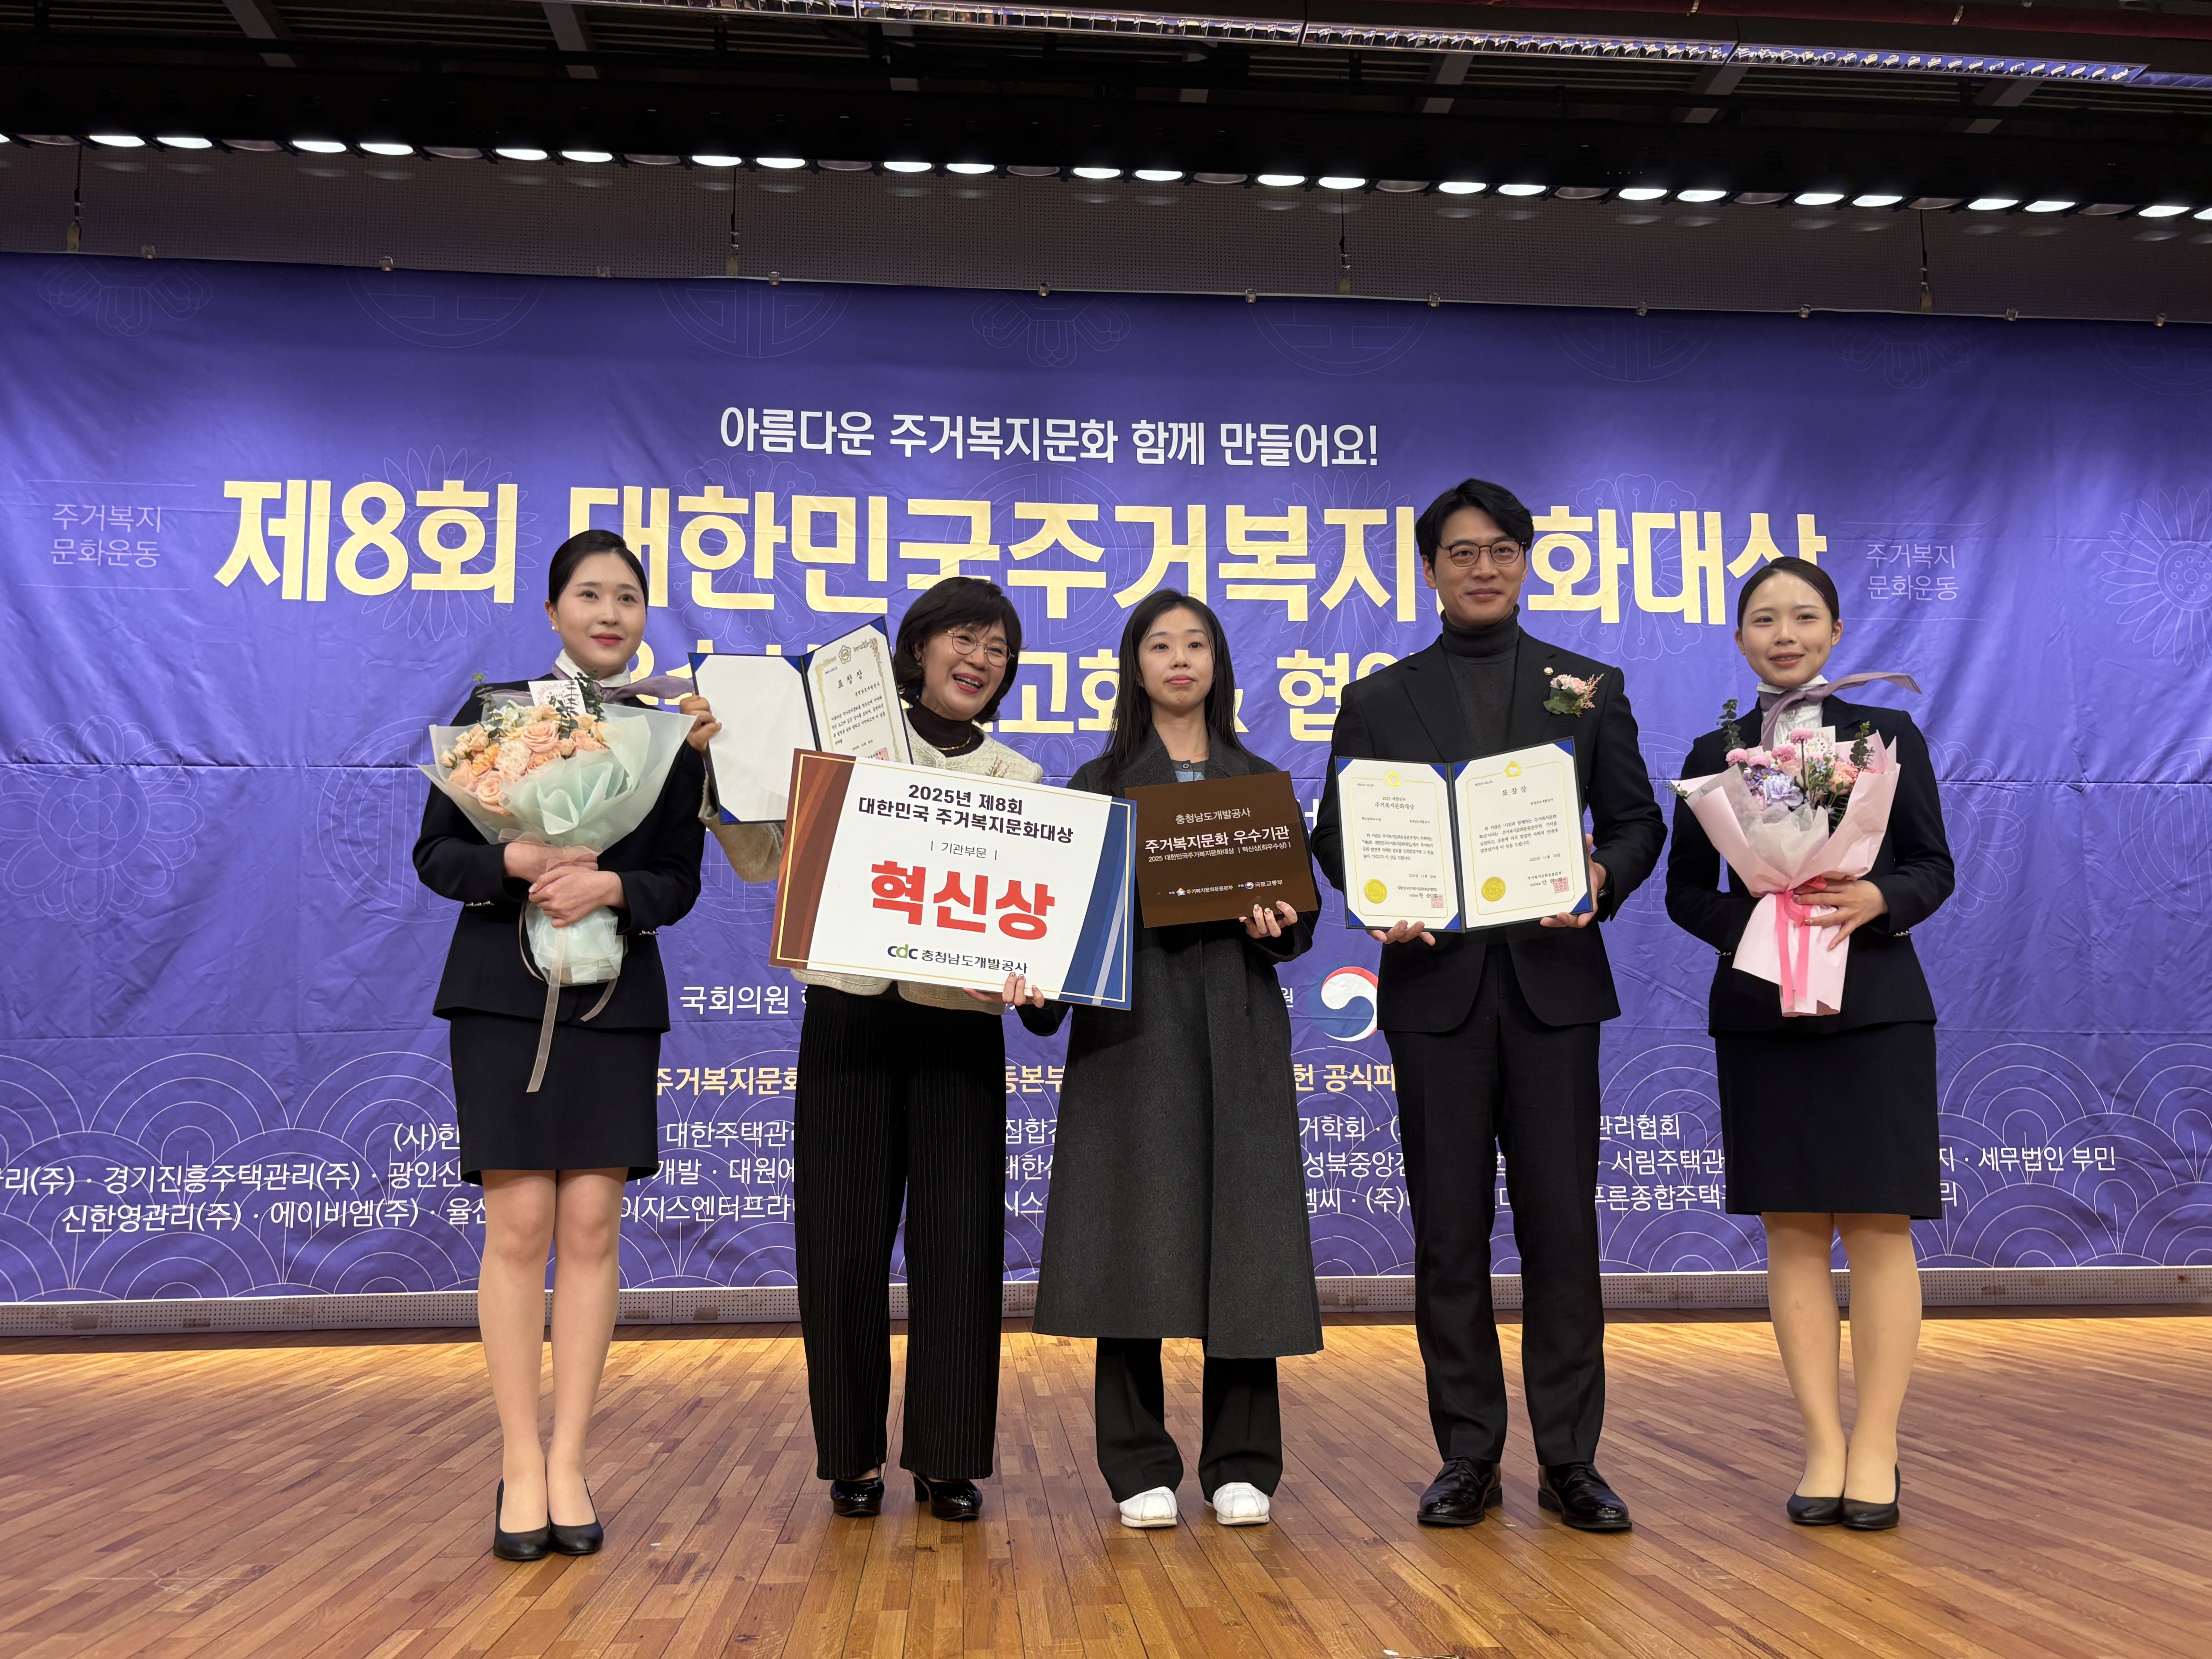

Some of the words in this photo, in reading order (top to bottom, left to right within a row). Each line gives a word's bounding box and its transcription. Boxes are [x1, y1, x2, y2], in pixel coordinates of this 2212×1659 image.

[720, 407, 875, 456] 아름다운
[890, 414, 1118, 464] 주거복지문화
[1131, 420, 1204, 465] 함께
[1220, 424, 1377, 467] 만들어요!
[52, 505, 160, 533] 주거복지
[50, 539, 160, 567] 문화운동
[214, 479, 518, 604] 제8회
[1866, 544, 1954, 569] 주거복지
[1868, 575, 1959, 600] 문화운동
[909, 785, 971, 807] 2025년
[979, 793, 1023, 815] 제8회
[859, 797, 929, 823] 대한민국
[936, 808, 1073, 844] 주거복지문화대상
[1175, 808, 1250, 824] 충청남도개발공사
[941, 843, 987, 859] 기관부문
[1145, 832, 1228, 853] 주거복지문화
[1233, 825, 1289, 844] 우수기관
[1164, 848, 1234, 861] 대한민국주거복지문화대상
[871, 860, 1055, 940] 혁신상
[887, 944, 918, 961] cdc
[921, 950, 1028, 974] 충청남도개발공사
[680, 986, 789, 1015] 국회의원
[666, 1121, 794, 1148] 대한주택관
[0, 1166, 74, 1195] 리(주)
[104, 1162, 360, 1195] 경기진흥주택관리(주)
[1978, 1146, 2064, 1172] 세무법인
[2072, 1146, 2116, 1171] 부민
[62, 1201, 242, 1233] 신한영관리(주)
[270, 1197, 418, 1229] 에이비엠(주)
